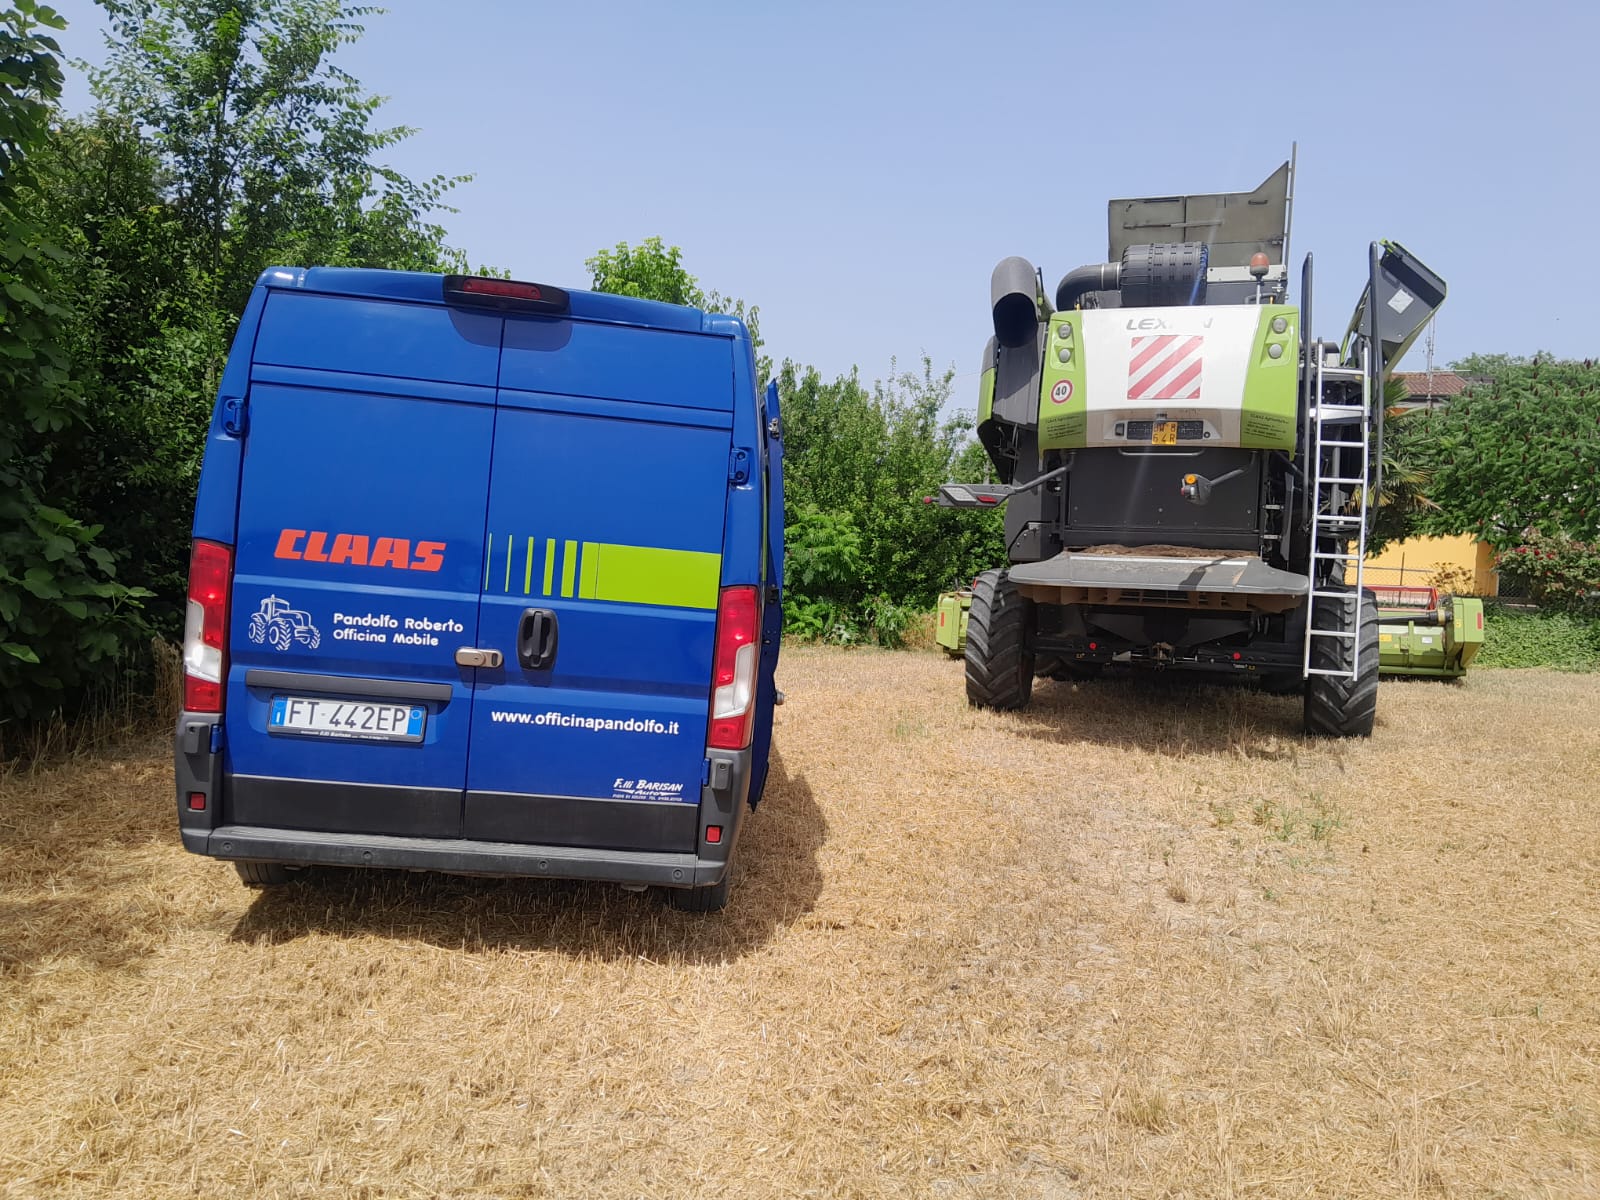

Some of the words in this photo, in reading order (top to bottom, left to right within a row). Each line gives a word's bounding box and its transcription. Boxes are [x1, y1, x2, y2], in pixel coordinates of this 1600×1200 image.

[1126, 317, 1213, 331] LEXN
[1055, 385, 1068, 397] 40
[273, 528, 447, 572] CLAAS
[333, 613, 399, 629] Pandolfo
[404, 617, 464, 633] Roberto
[333, 628, 387, 643] Officina
[392, 633, 439, 646] Mobile
[491, 711, 680, 735] www.officinapandolfo.it
[636, 780, 684, 792] BARISAN
